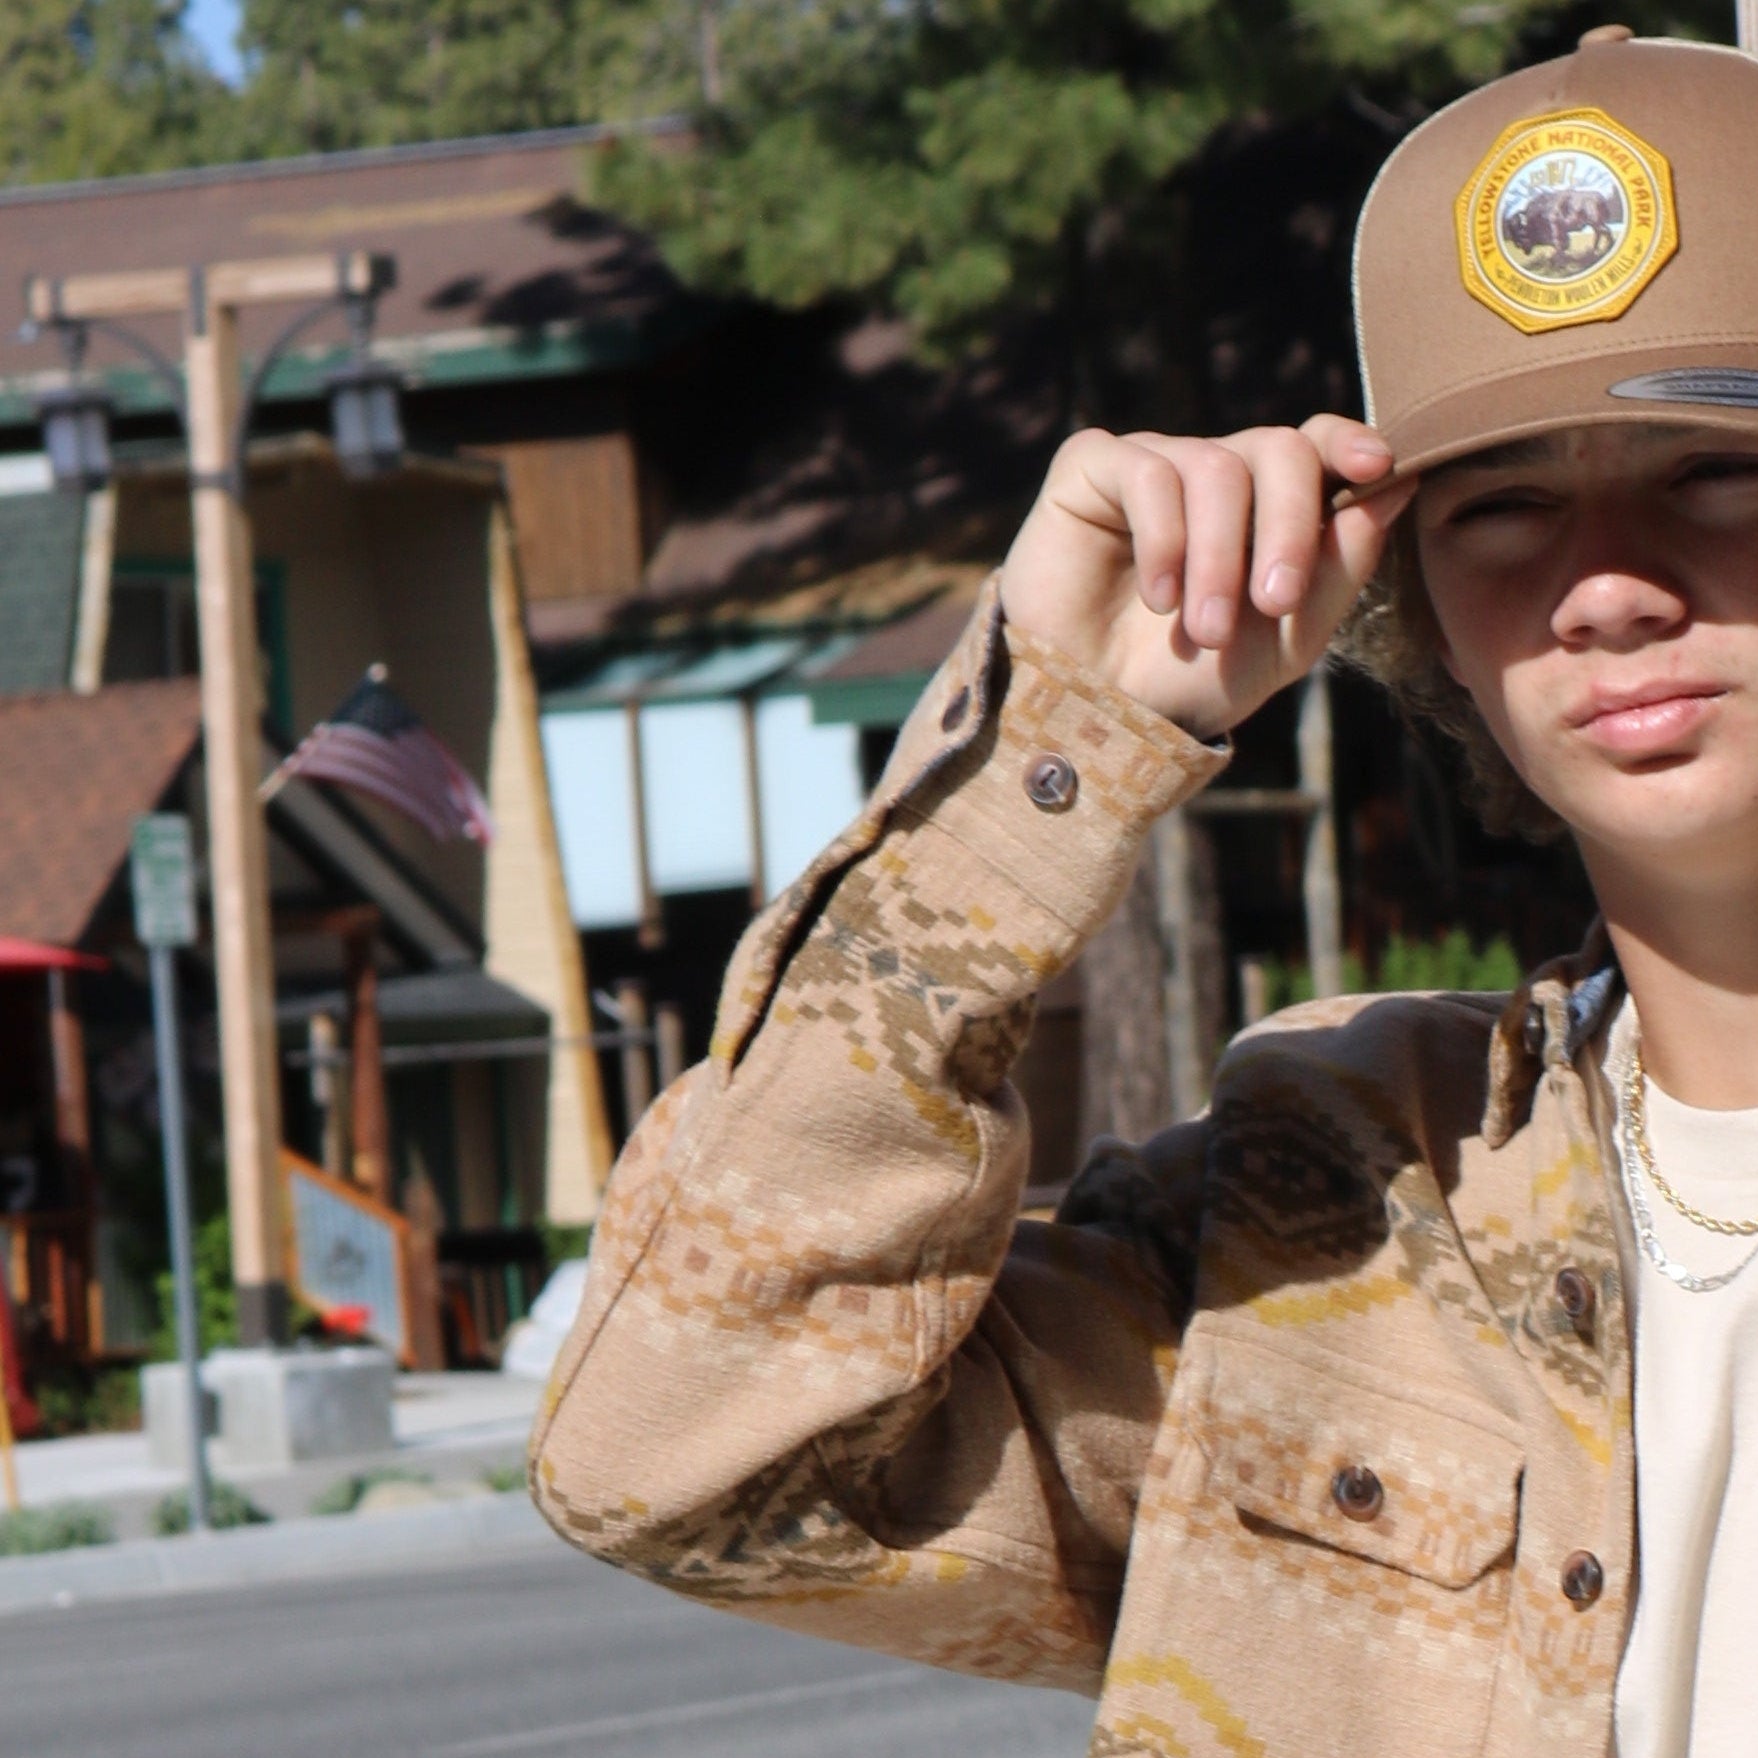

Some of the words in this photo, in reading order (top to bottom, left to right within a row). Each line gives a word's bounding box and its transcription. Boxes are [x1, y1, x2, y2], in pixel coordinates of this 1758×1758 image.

[1478, 138, 1539, 258] YELLOWSTONE
[1548, 131, 1632, 173] NATIONAL
[1630, 175, 1651, 228] PARK
[1606, 254, 1634, 282] MILLS
